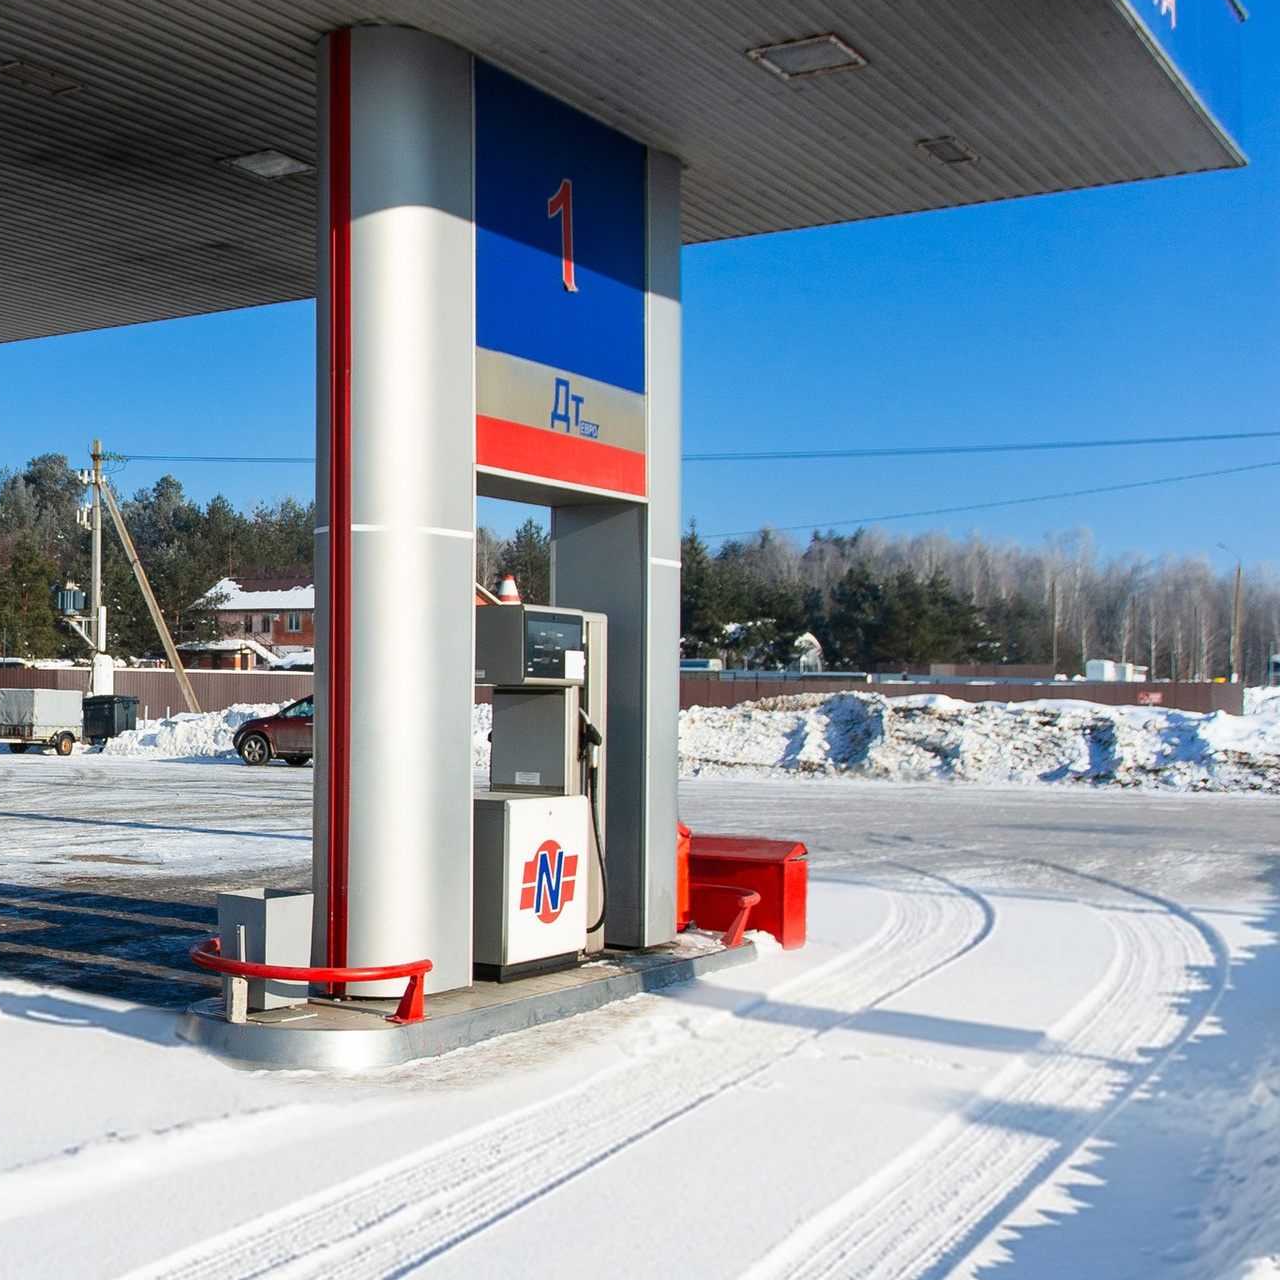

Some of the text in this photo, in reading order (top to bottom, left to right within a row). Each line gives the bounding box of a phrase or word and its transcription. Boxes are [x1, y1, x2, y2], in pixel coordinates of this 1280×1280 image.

[547, 177, 579, 294] 1
[551, 377, 584, 433] Дт
[534, 850, 564, 914] N
